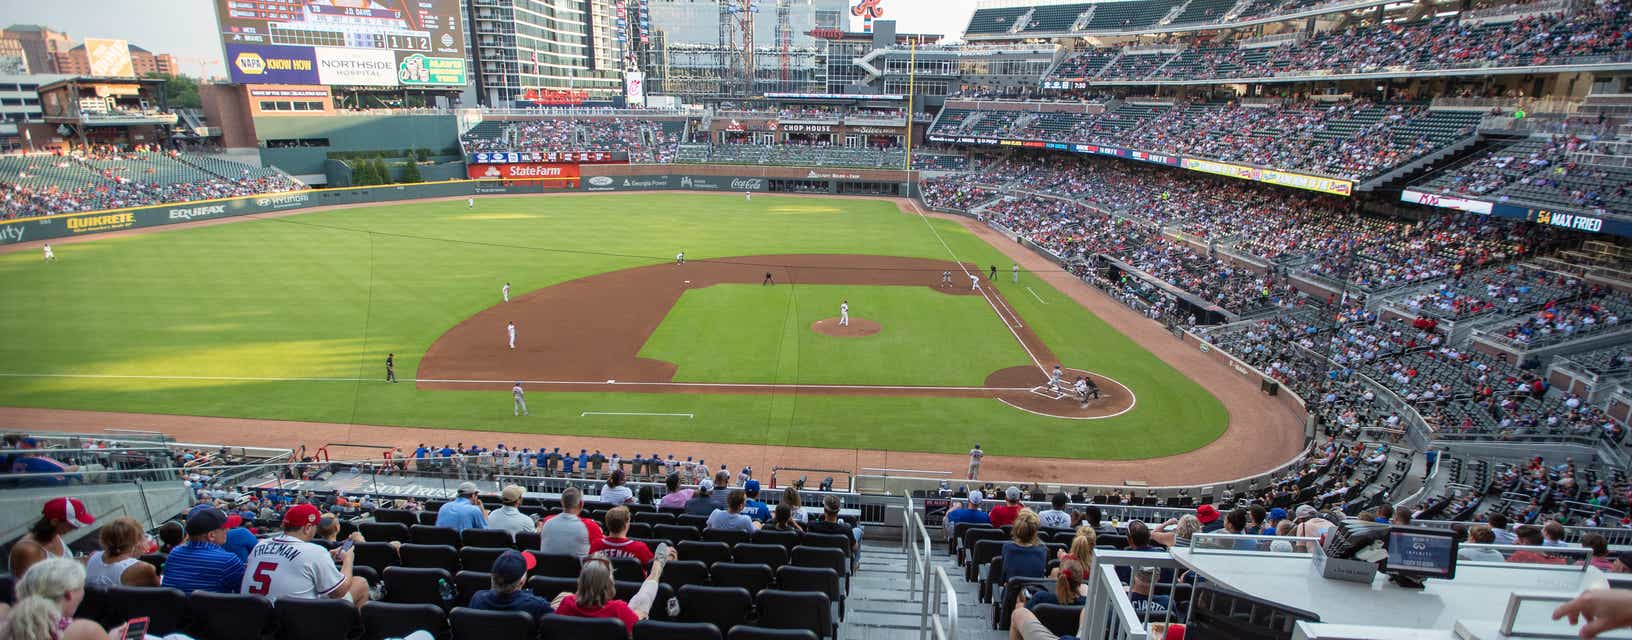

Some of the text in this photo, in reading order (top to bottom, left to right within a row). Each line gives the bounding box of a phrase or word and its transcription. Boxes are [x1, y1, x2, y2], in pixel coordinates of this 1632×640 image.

[356, 9, 372, 17] DAVIS
[241, 58, 262, 69] NAPA
[266, 59, 312, 71] KNOW HOW
[321, 59, 393, 70] NORTHSIDE
[336, 69, 383, 78] HOSPITAL
[169, 204, 225, 219] EQUIFAX
[66, 213, 136, 229] QUIKRETE
[1537, 210, 1602, 232] 54 MAX FRIED
[254, 542, 301, 561] FREEMAN
[248, 561, 279, 597] 5
